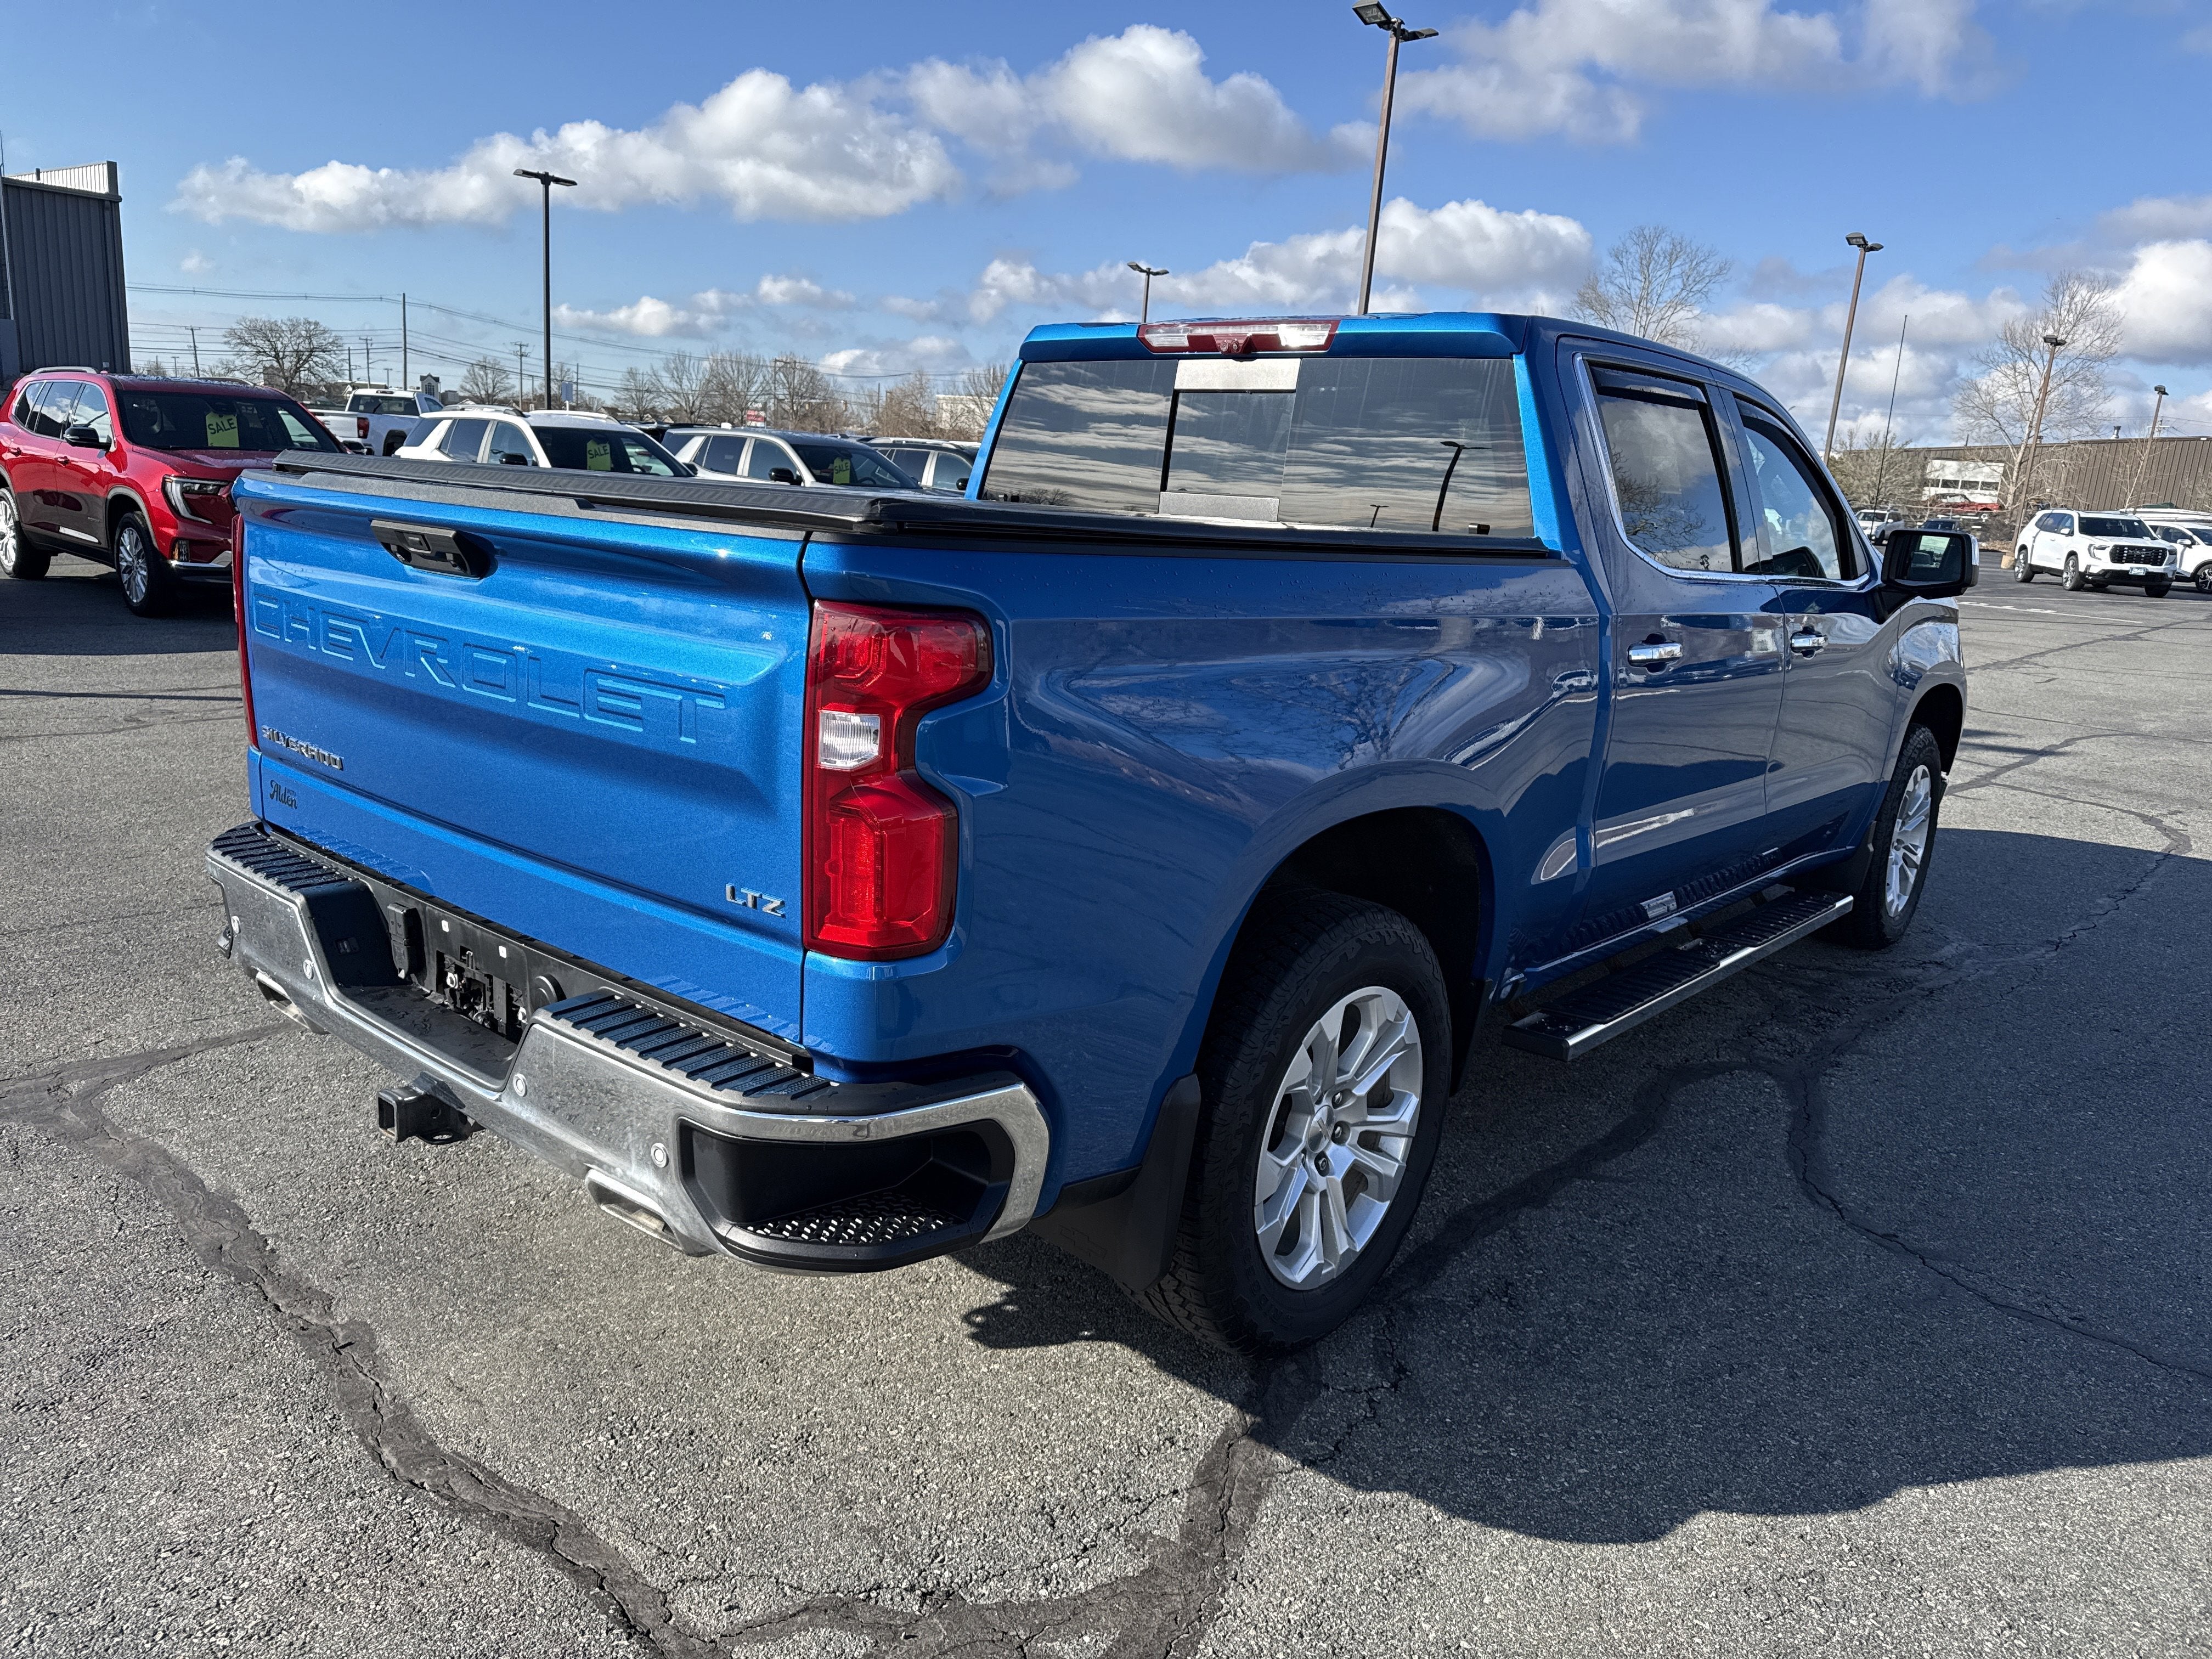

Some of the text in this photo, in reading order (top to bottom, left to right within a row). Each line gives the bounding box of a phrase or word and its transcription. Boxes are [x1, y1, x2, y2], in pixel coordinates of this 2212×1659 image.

[207, 418, 236, 435] SALE
[588, 445, 609, 459] SALE
[834, 462, 850, 474] SALE
[253, 593, 725, 743] CHEVROLET
[262, 725, 344, 771] SILVERADO
[269, 779, 297, 809] Alden
[725, 883, 786, 918] LTZ
